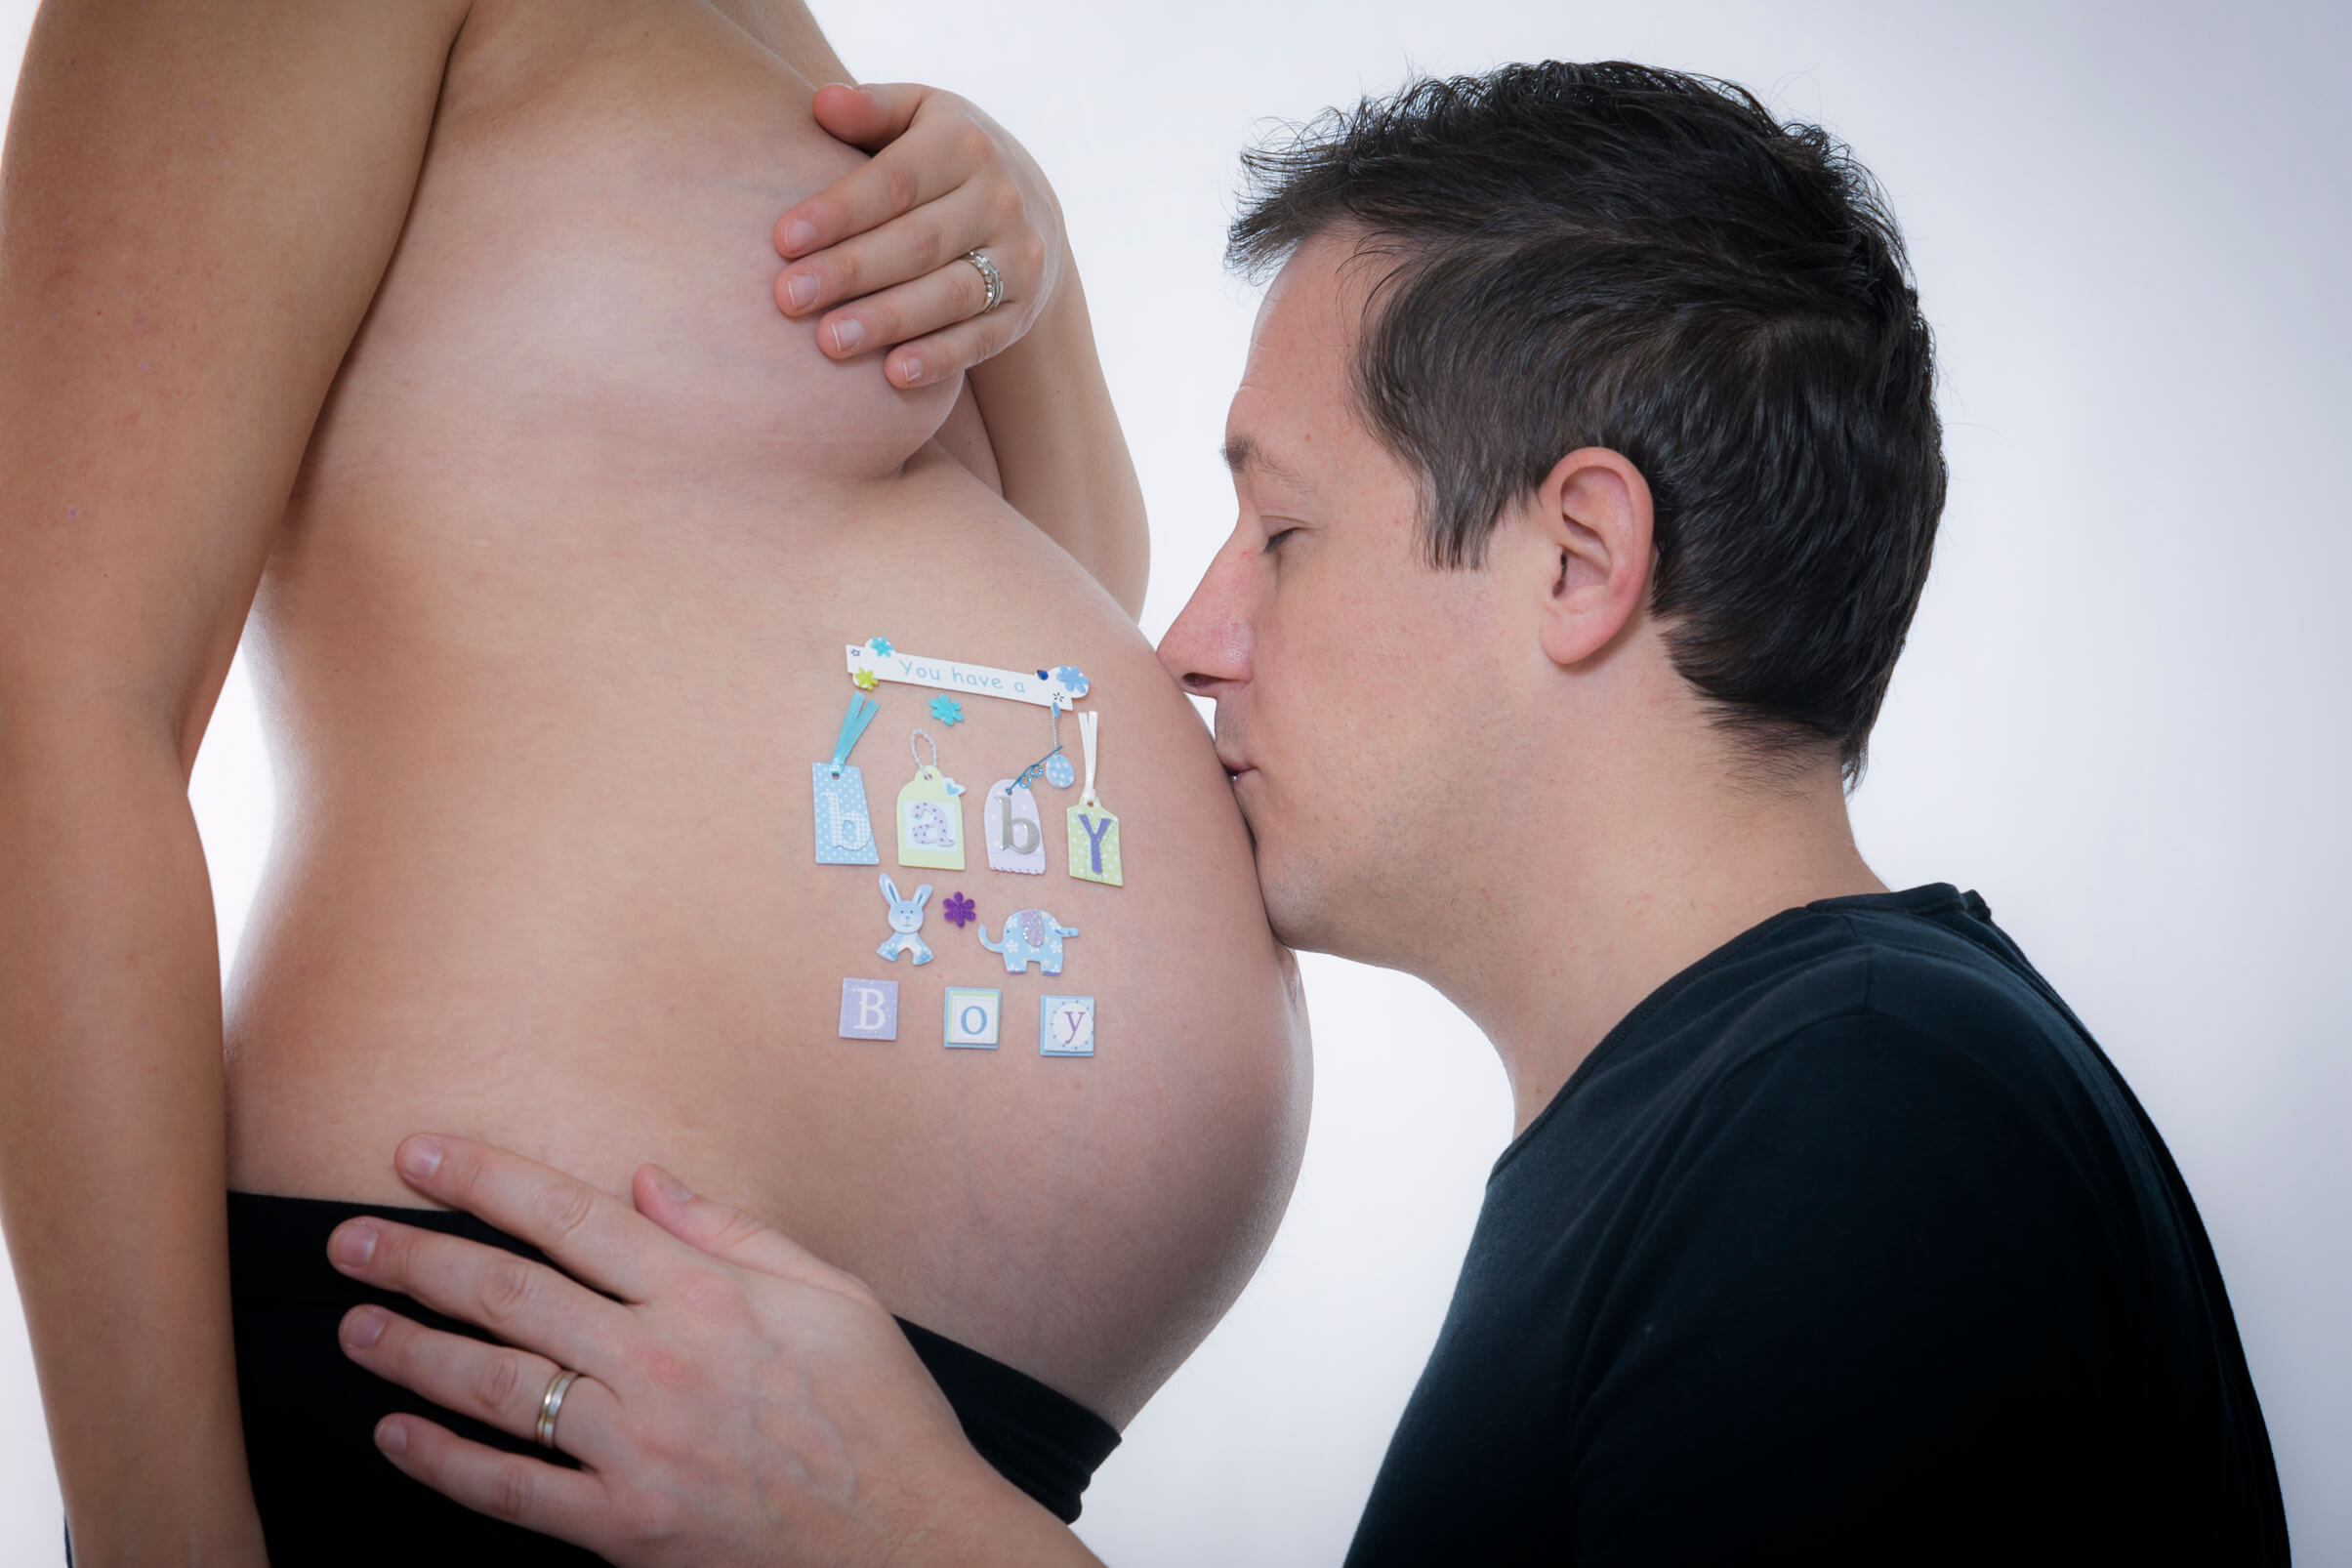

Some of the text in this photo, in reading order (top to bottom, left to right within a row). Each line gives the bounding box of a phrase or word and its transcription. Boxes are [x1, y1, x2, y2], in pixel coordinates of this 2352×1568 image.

[899, 660, 1025, 693] You have a
